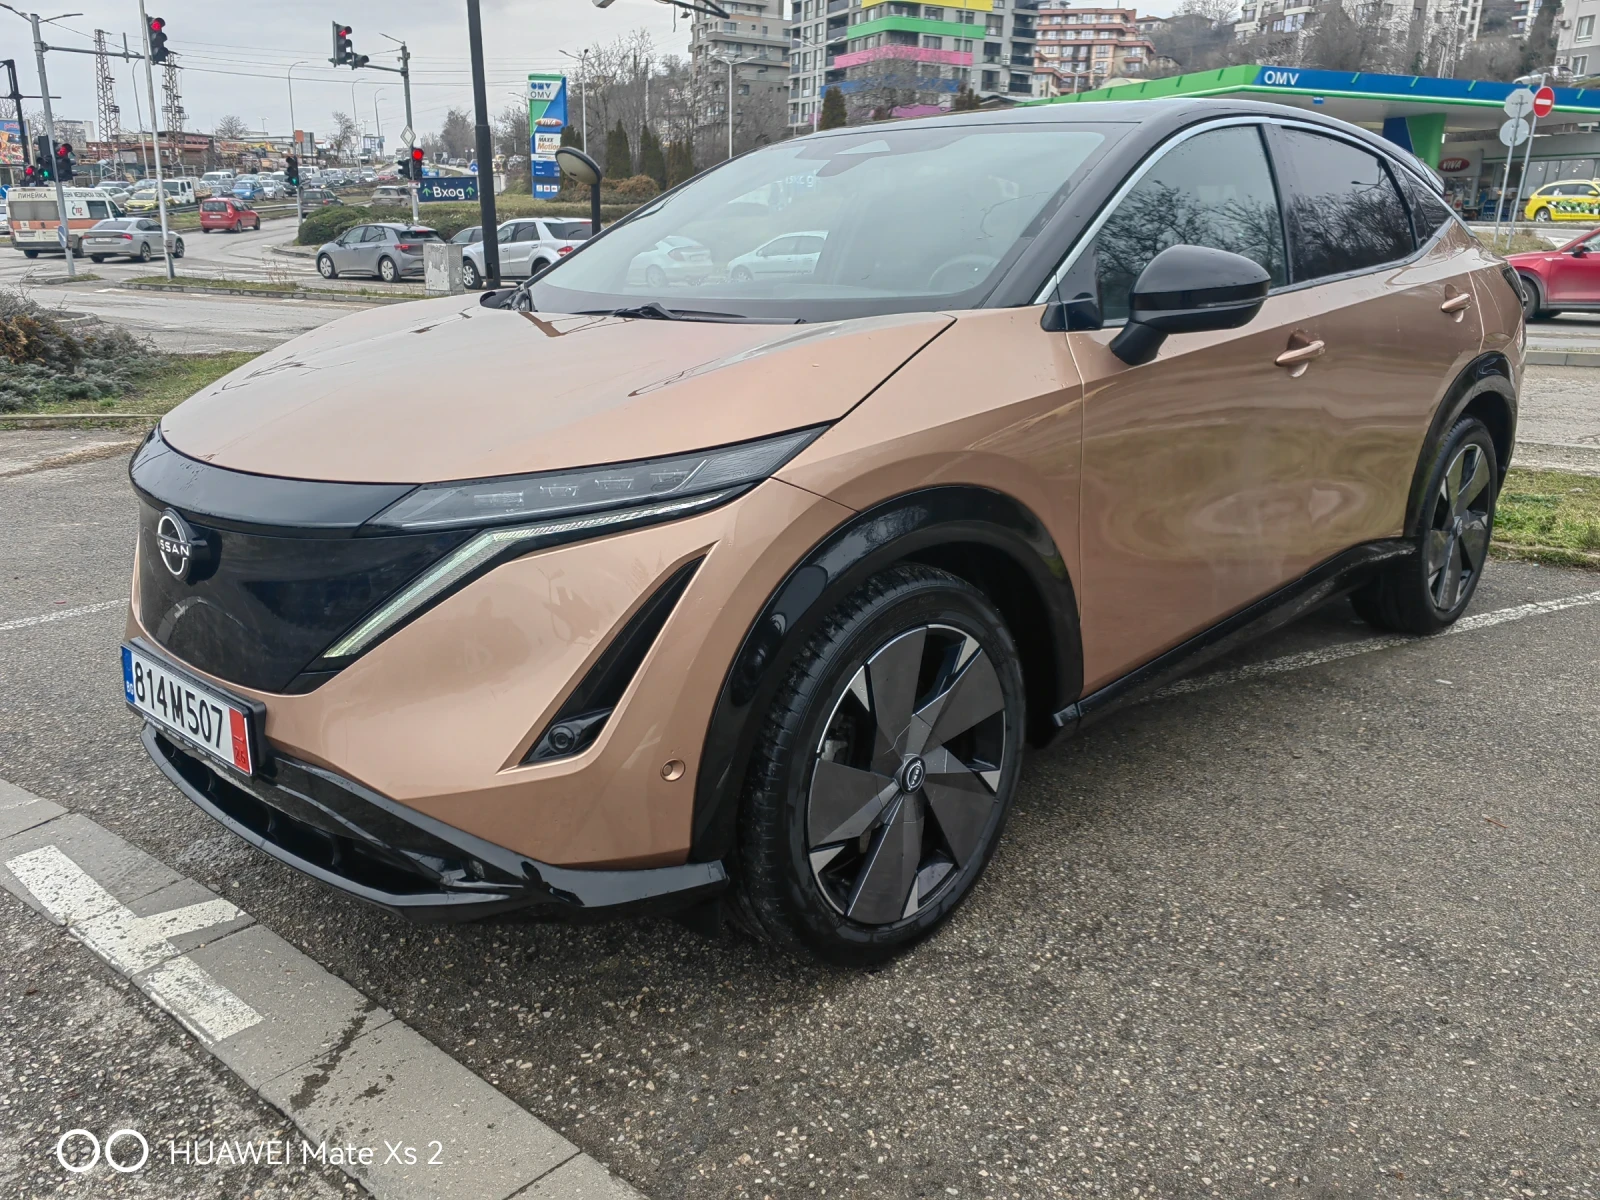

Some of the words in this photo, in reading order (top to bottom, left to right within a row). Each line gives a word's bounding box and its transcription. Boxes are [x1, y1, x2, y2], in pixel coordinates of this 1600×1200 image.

[1264, 70, 1299, 85] OMV
[1442, 159, 1463, 170] VIVA
[126, 681, 134, 696] BG
[134, 661, 223, 749] 814M507
